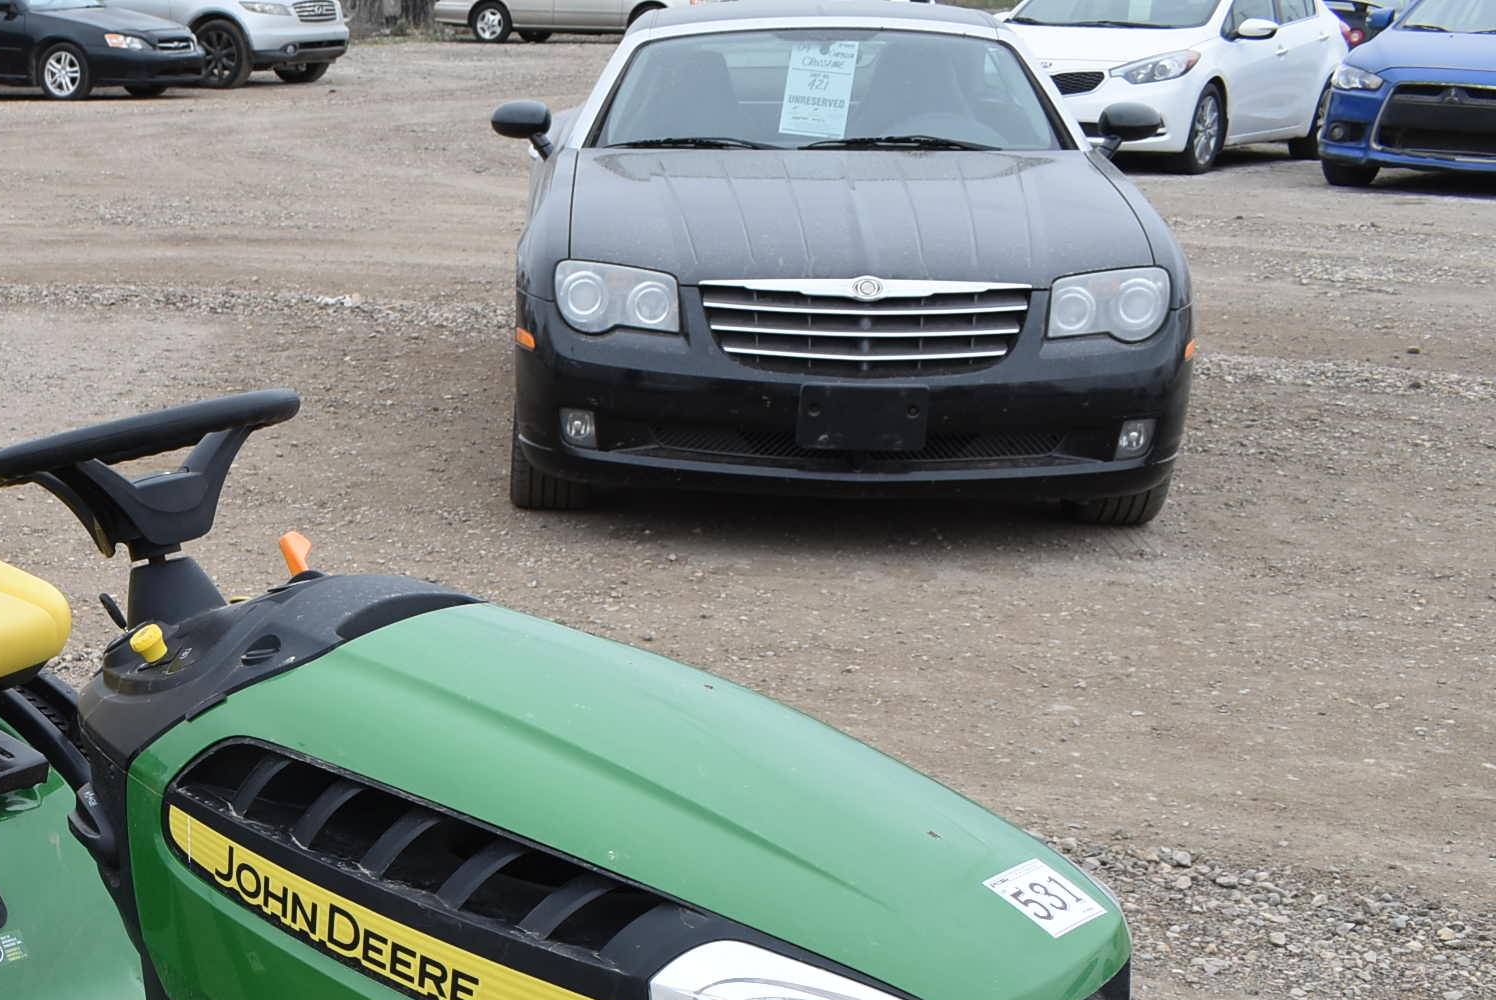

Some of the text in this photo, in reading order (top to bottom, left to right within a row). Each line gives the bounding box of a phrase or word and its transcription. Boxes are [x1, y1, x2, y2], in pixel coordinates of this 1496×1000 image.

[788, 94, 845, 109] UNRESERVED
[214, 845, 318, 935] JOHN
[1010, 876, 1083, 921] 531
